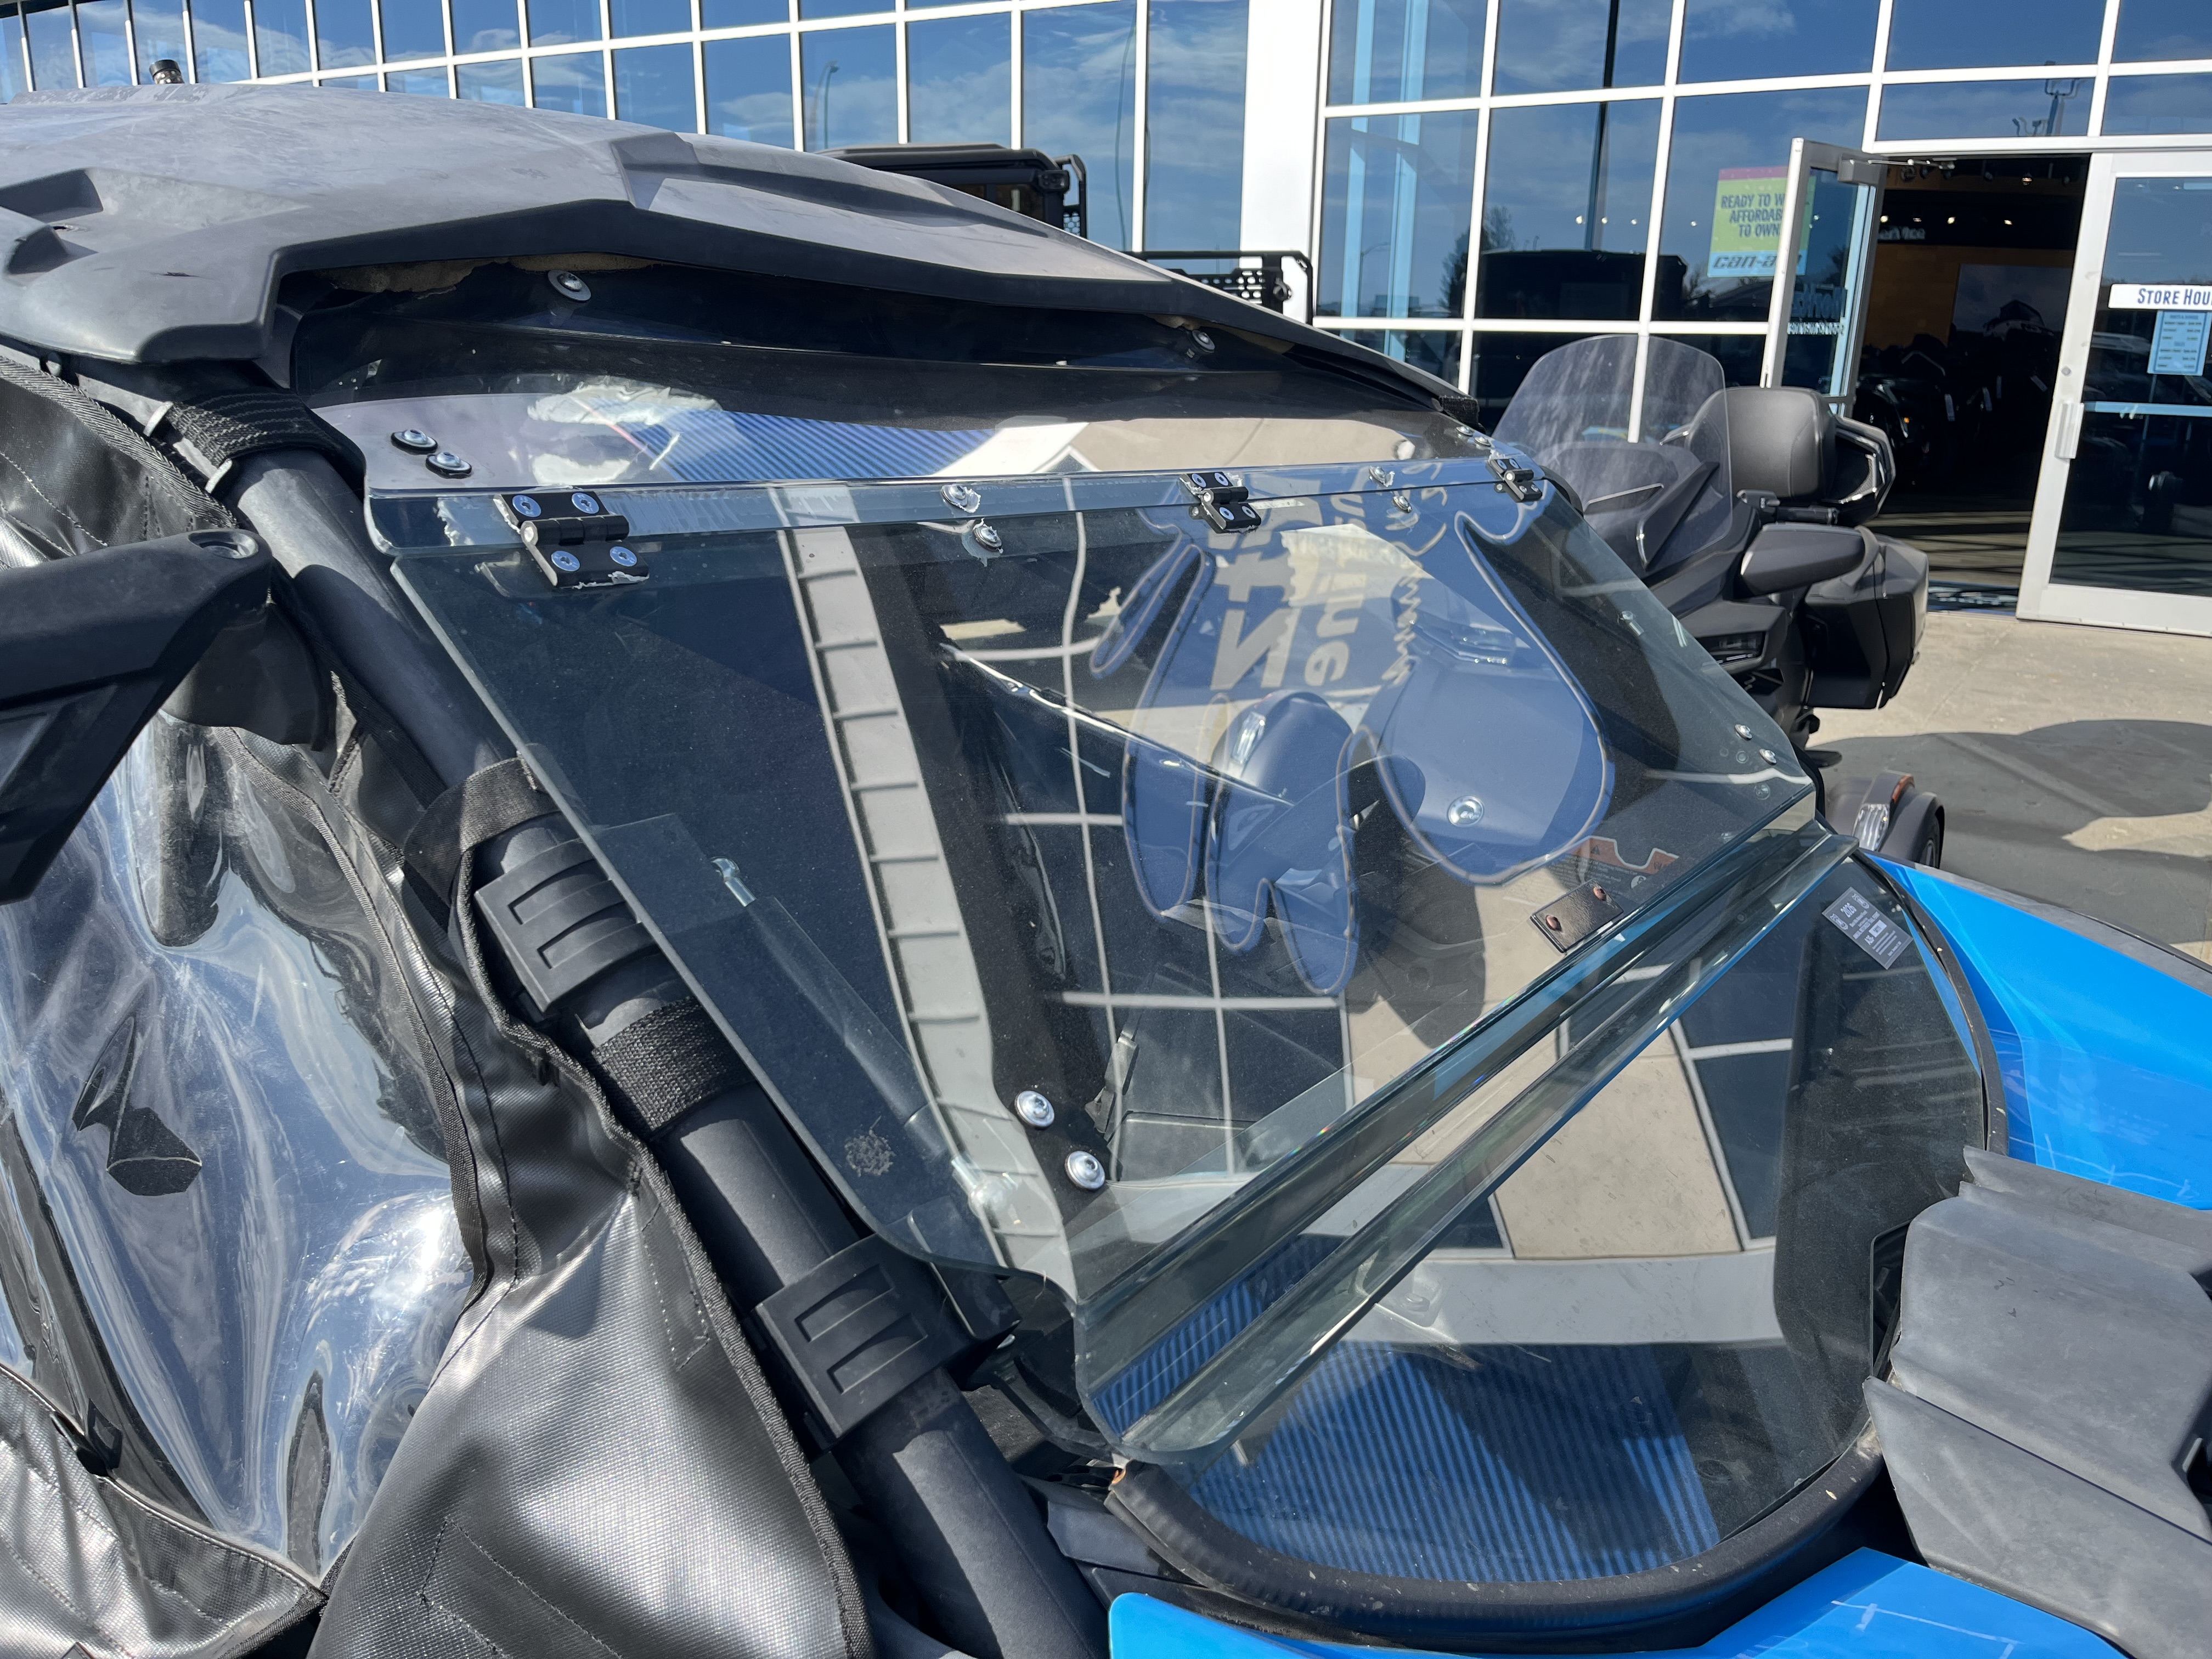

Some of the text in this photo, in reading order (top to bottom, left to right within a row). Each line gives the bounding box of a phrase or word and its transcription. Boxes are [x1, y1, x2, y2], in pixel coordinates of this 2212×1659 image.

[1721, 194, 1754, 208] READY
[1758, 193, 1771, 207] TO
[1729, 208, 1783, 223] AFFORDAB
[1739, 224, 1752, 238] TO
[1713, 255, 1778, 269] can-a
[2137, 287, 2212, 306] STORE HOU
